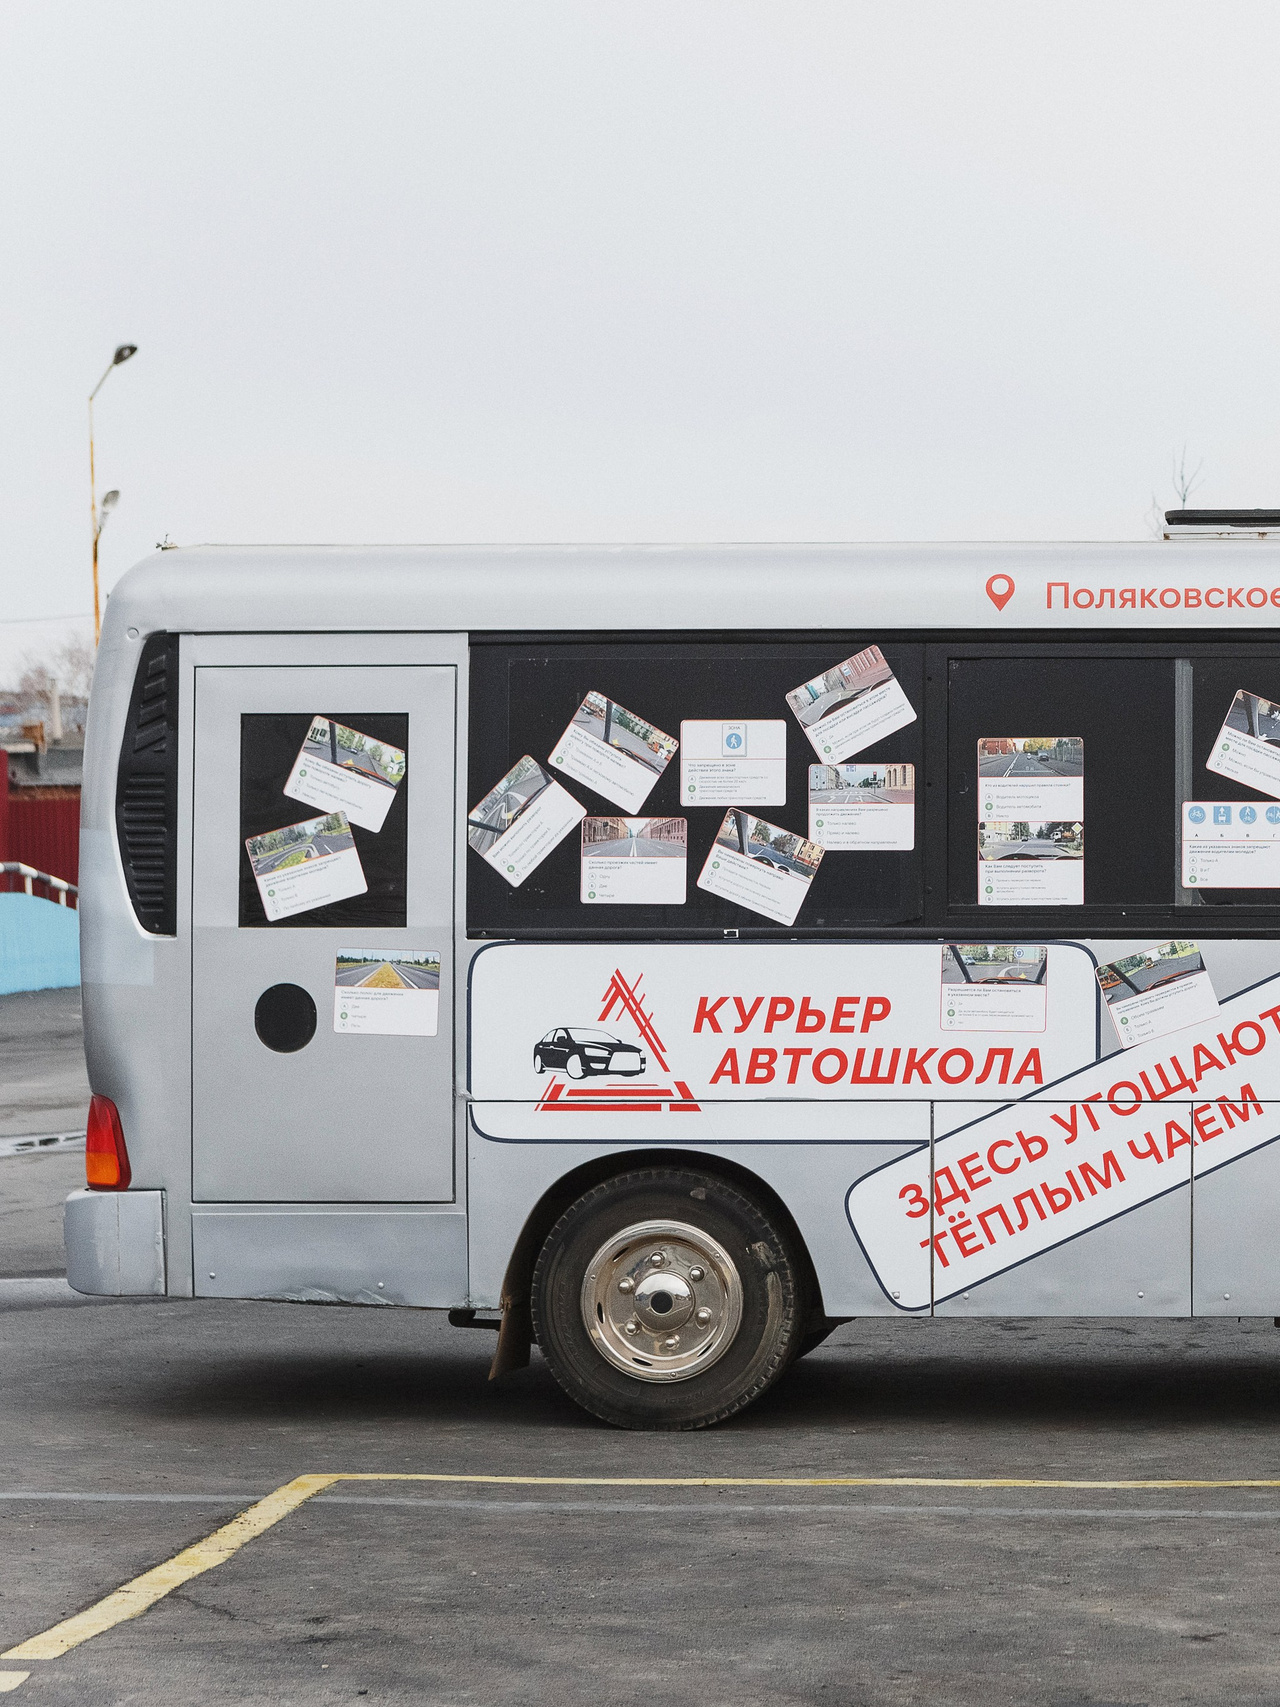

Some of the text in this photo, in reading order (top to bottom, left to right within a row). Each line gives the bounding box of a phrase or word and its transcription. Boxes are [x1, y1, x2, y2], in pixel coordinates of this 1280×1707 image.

[692, 995, 892, 1035] КУРЬЕР
[708, 1047, 1044, 1085] АВТОШКОЛА
[898, 1130, 1050, 1220] ЗДЕСЬ
[918, 1081, 1266, 1270] ТЁПЛЫМ ЧАЕМ
